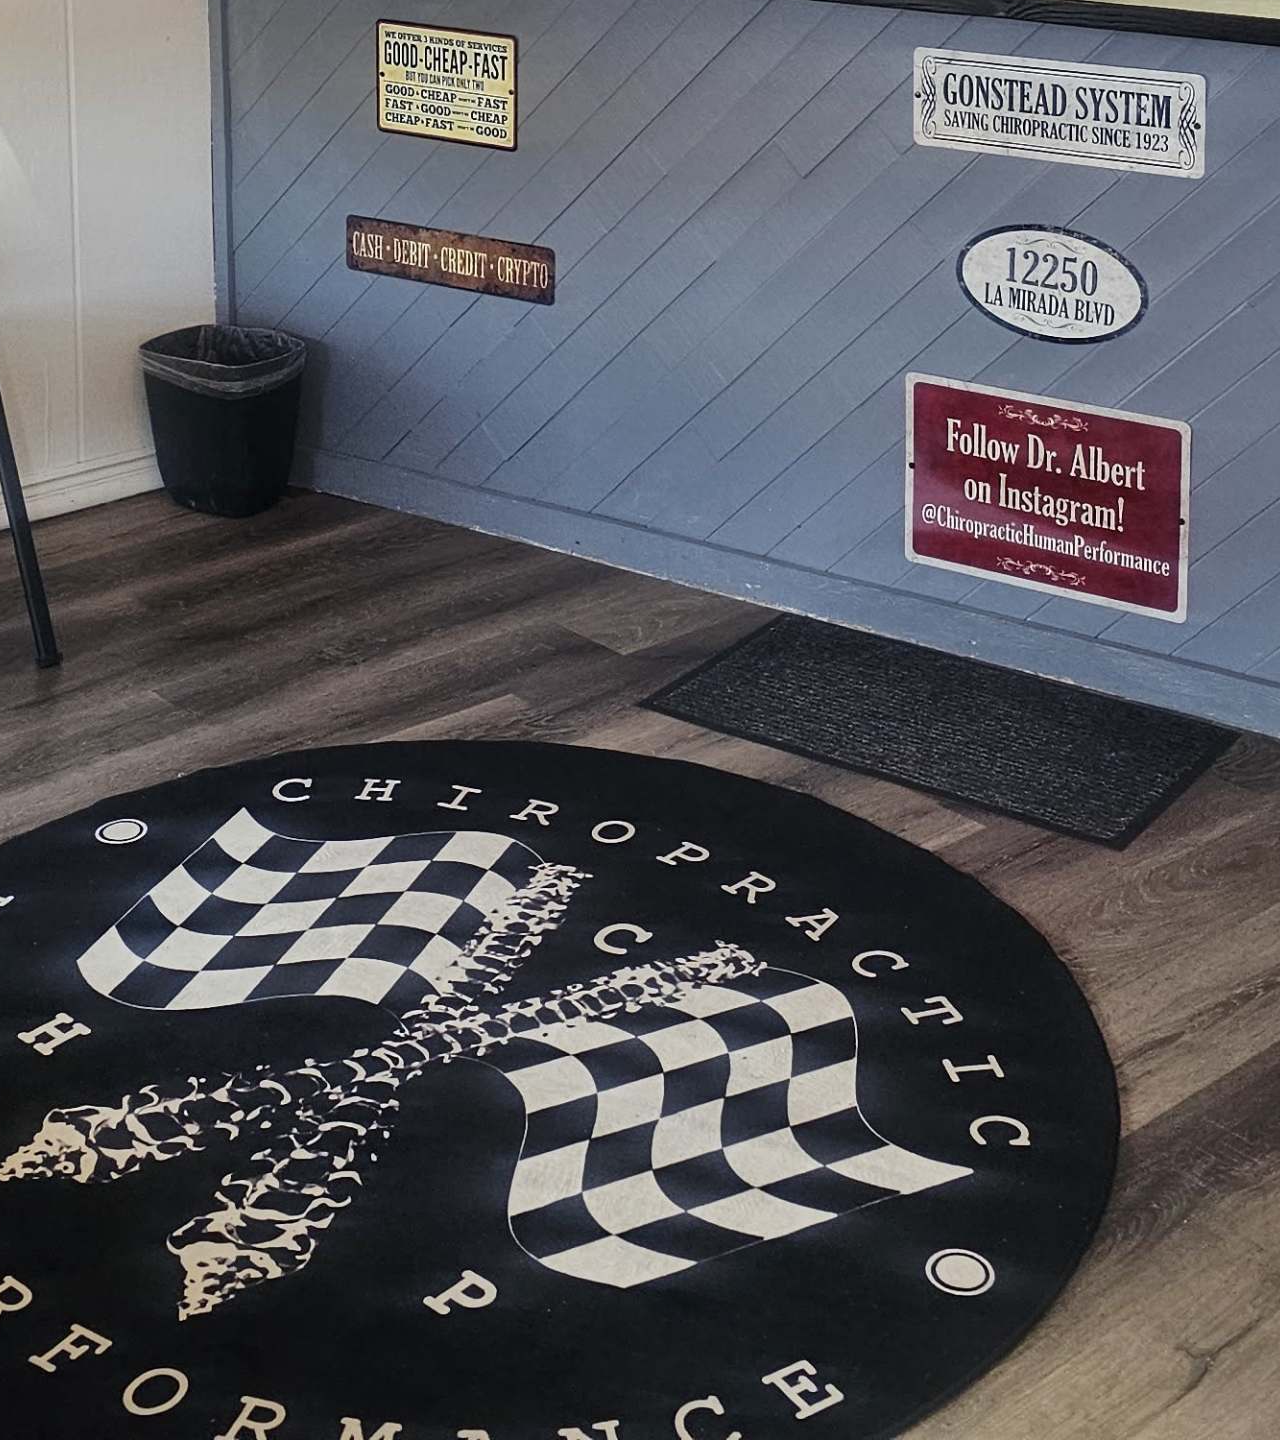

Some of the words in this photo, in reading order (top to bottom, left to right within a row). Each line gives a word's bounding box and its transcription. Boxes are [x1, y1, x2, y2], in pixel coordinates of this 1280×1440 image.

[384, 31, 396, 39] WE
[429, 36, 454, 47] KINDS
[455, 39, 466, 48] OF
[467, 40, 508, 53] SERVICES
[385, 84, 415, 97] GOOD
[421, 89, 457, 103] CHEAP
[477, 97, 508, 111] FAST
[405, 70, 416, 81] BUT
[417, 72, 429, 83] YOU
[442, 76, 455, 87] PICK
[943, 72, 1067, 116] GONSTEAD
[1075, 86, 1172, 129] SYSTEM
[385, 98, 414, 111] FAST
[421, 103, 451, 116] GOOD
[470, 110, 508, 125] CHEAP
[385, 112, 420, 126] CHEAP
[425, 117, 455, 131] FAST
[476, 126, 508, 139] GOOD
[943, 110, 989, 131] SAVING
[992, 115, 1088, 143] CHIROPRACTIC
[1091, 127, 1131, 148] SINCE
[1135, 133, 1169, 152] 1923
[352, 231, 383, 260] CASH
[393, 238, 431, 268] DEBIT
[440, 246, 487, 278] CREDIT
[497, 256, 548, 288] CRYPTO
[1006, 247, 1098, 296] 12250
[984, 282, 1003, 306] LA
[1009, 288, 1069, 320] MIRADA
[1074, 299, 1115, 327] BLVD
[946, 418, 1020, 465] Follow
[1027, 433, 1062, 474] Dr.
[1070, 443, 1146, 491] Albert
[964, 478, 992, 504] on
[998, 473, 1125, 532] Instagram!
[921, 503, 1170, 577] @ChiropracticHumanPerformance
[272, 777, 1032, 1150] CHIROPRACTIC
